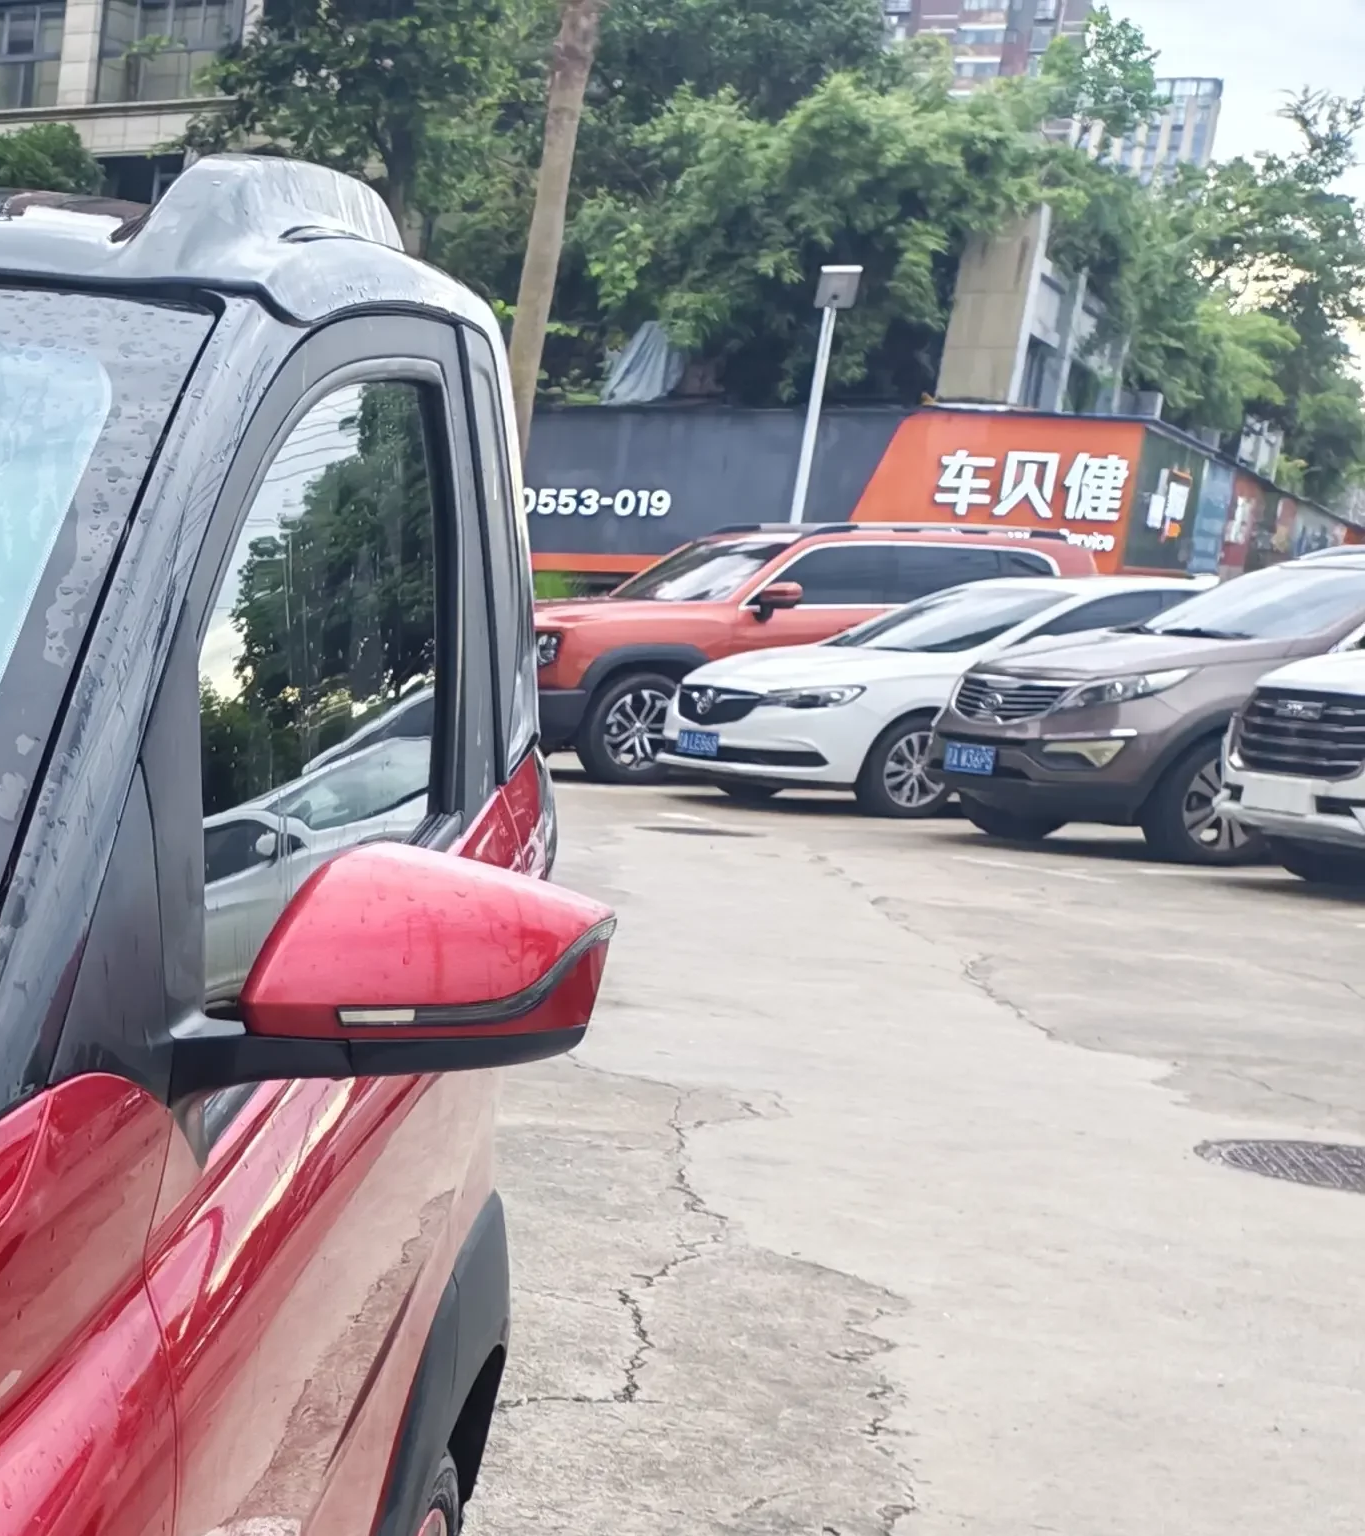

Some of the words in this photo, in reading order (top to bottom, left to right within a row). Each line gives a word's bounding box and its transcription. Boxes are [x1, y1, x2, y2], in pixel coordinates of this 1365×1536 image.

[522, 487, 672, 517] 0553-019
[934, 449, 1129, 521] 车贝健
